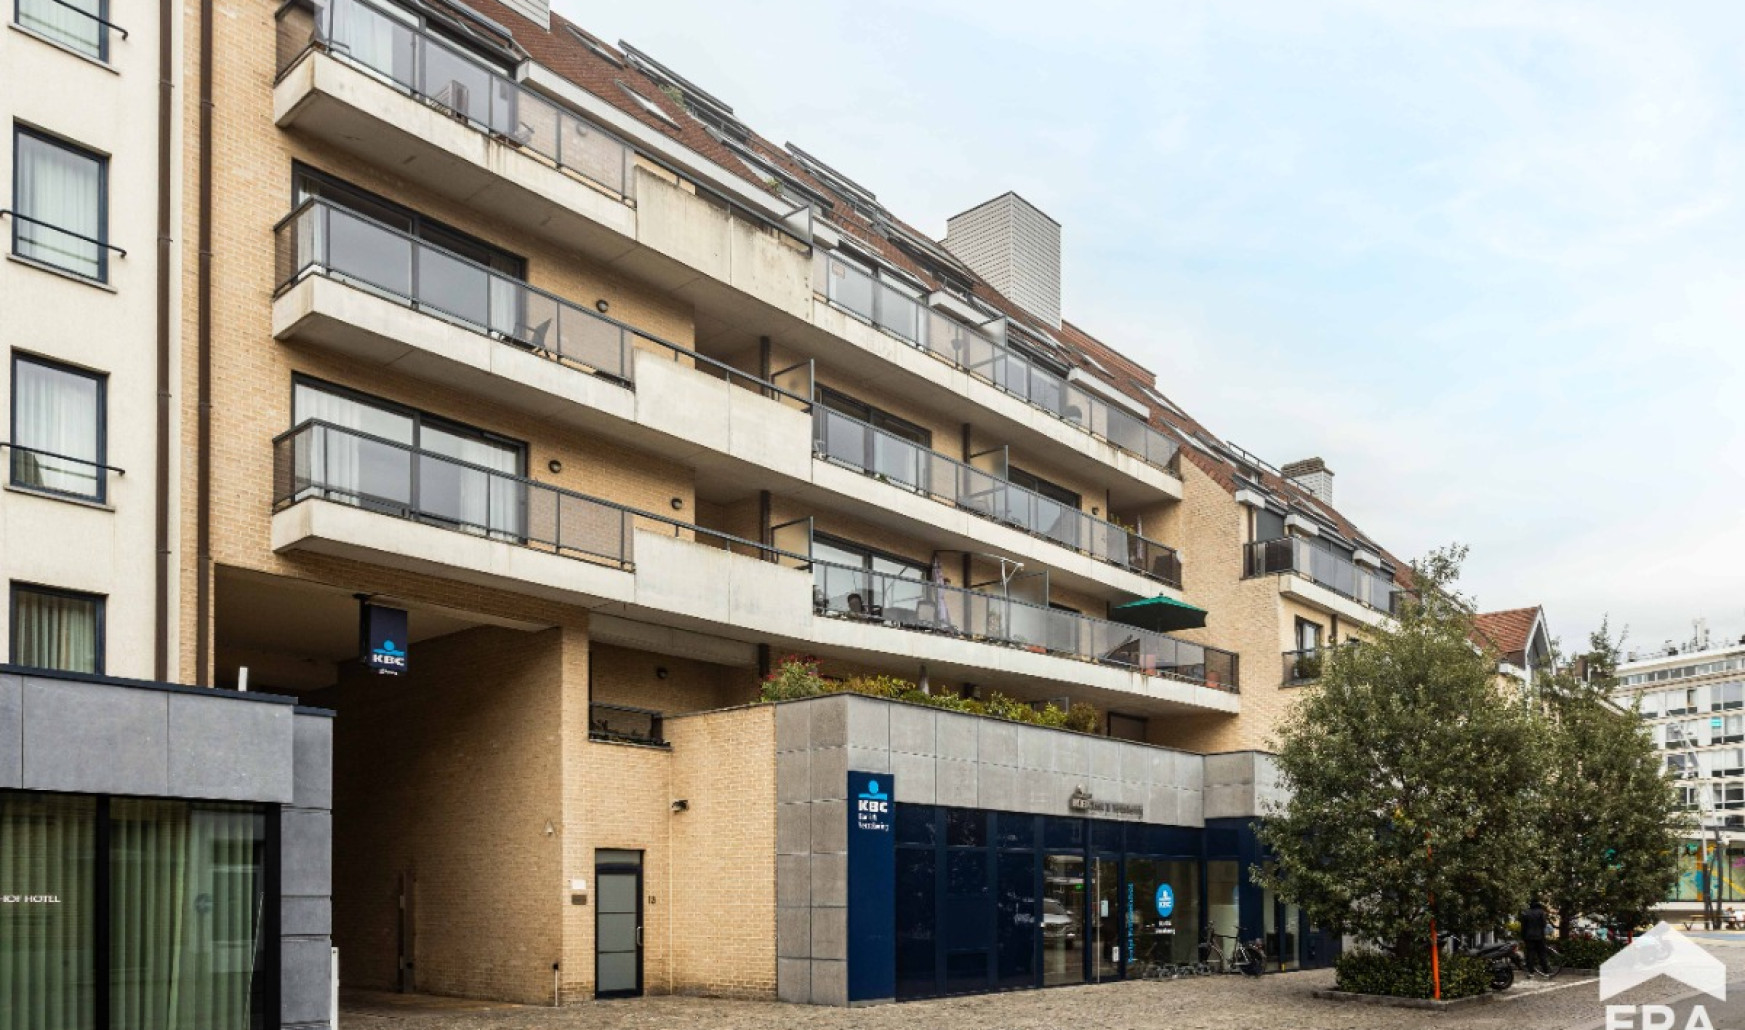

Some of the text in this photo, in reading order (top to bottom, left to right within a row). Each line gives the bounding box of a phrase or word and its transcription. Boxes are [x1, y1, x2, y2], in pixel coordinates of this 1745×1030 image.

[373, 654, 405, 666] KBC
[858, 800, 888, 813] KBC
[24, 895, 61, 903] HOTEL
